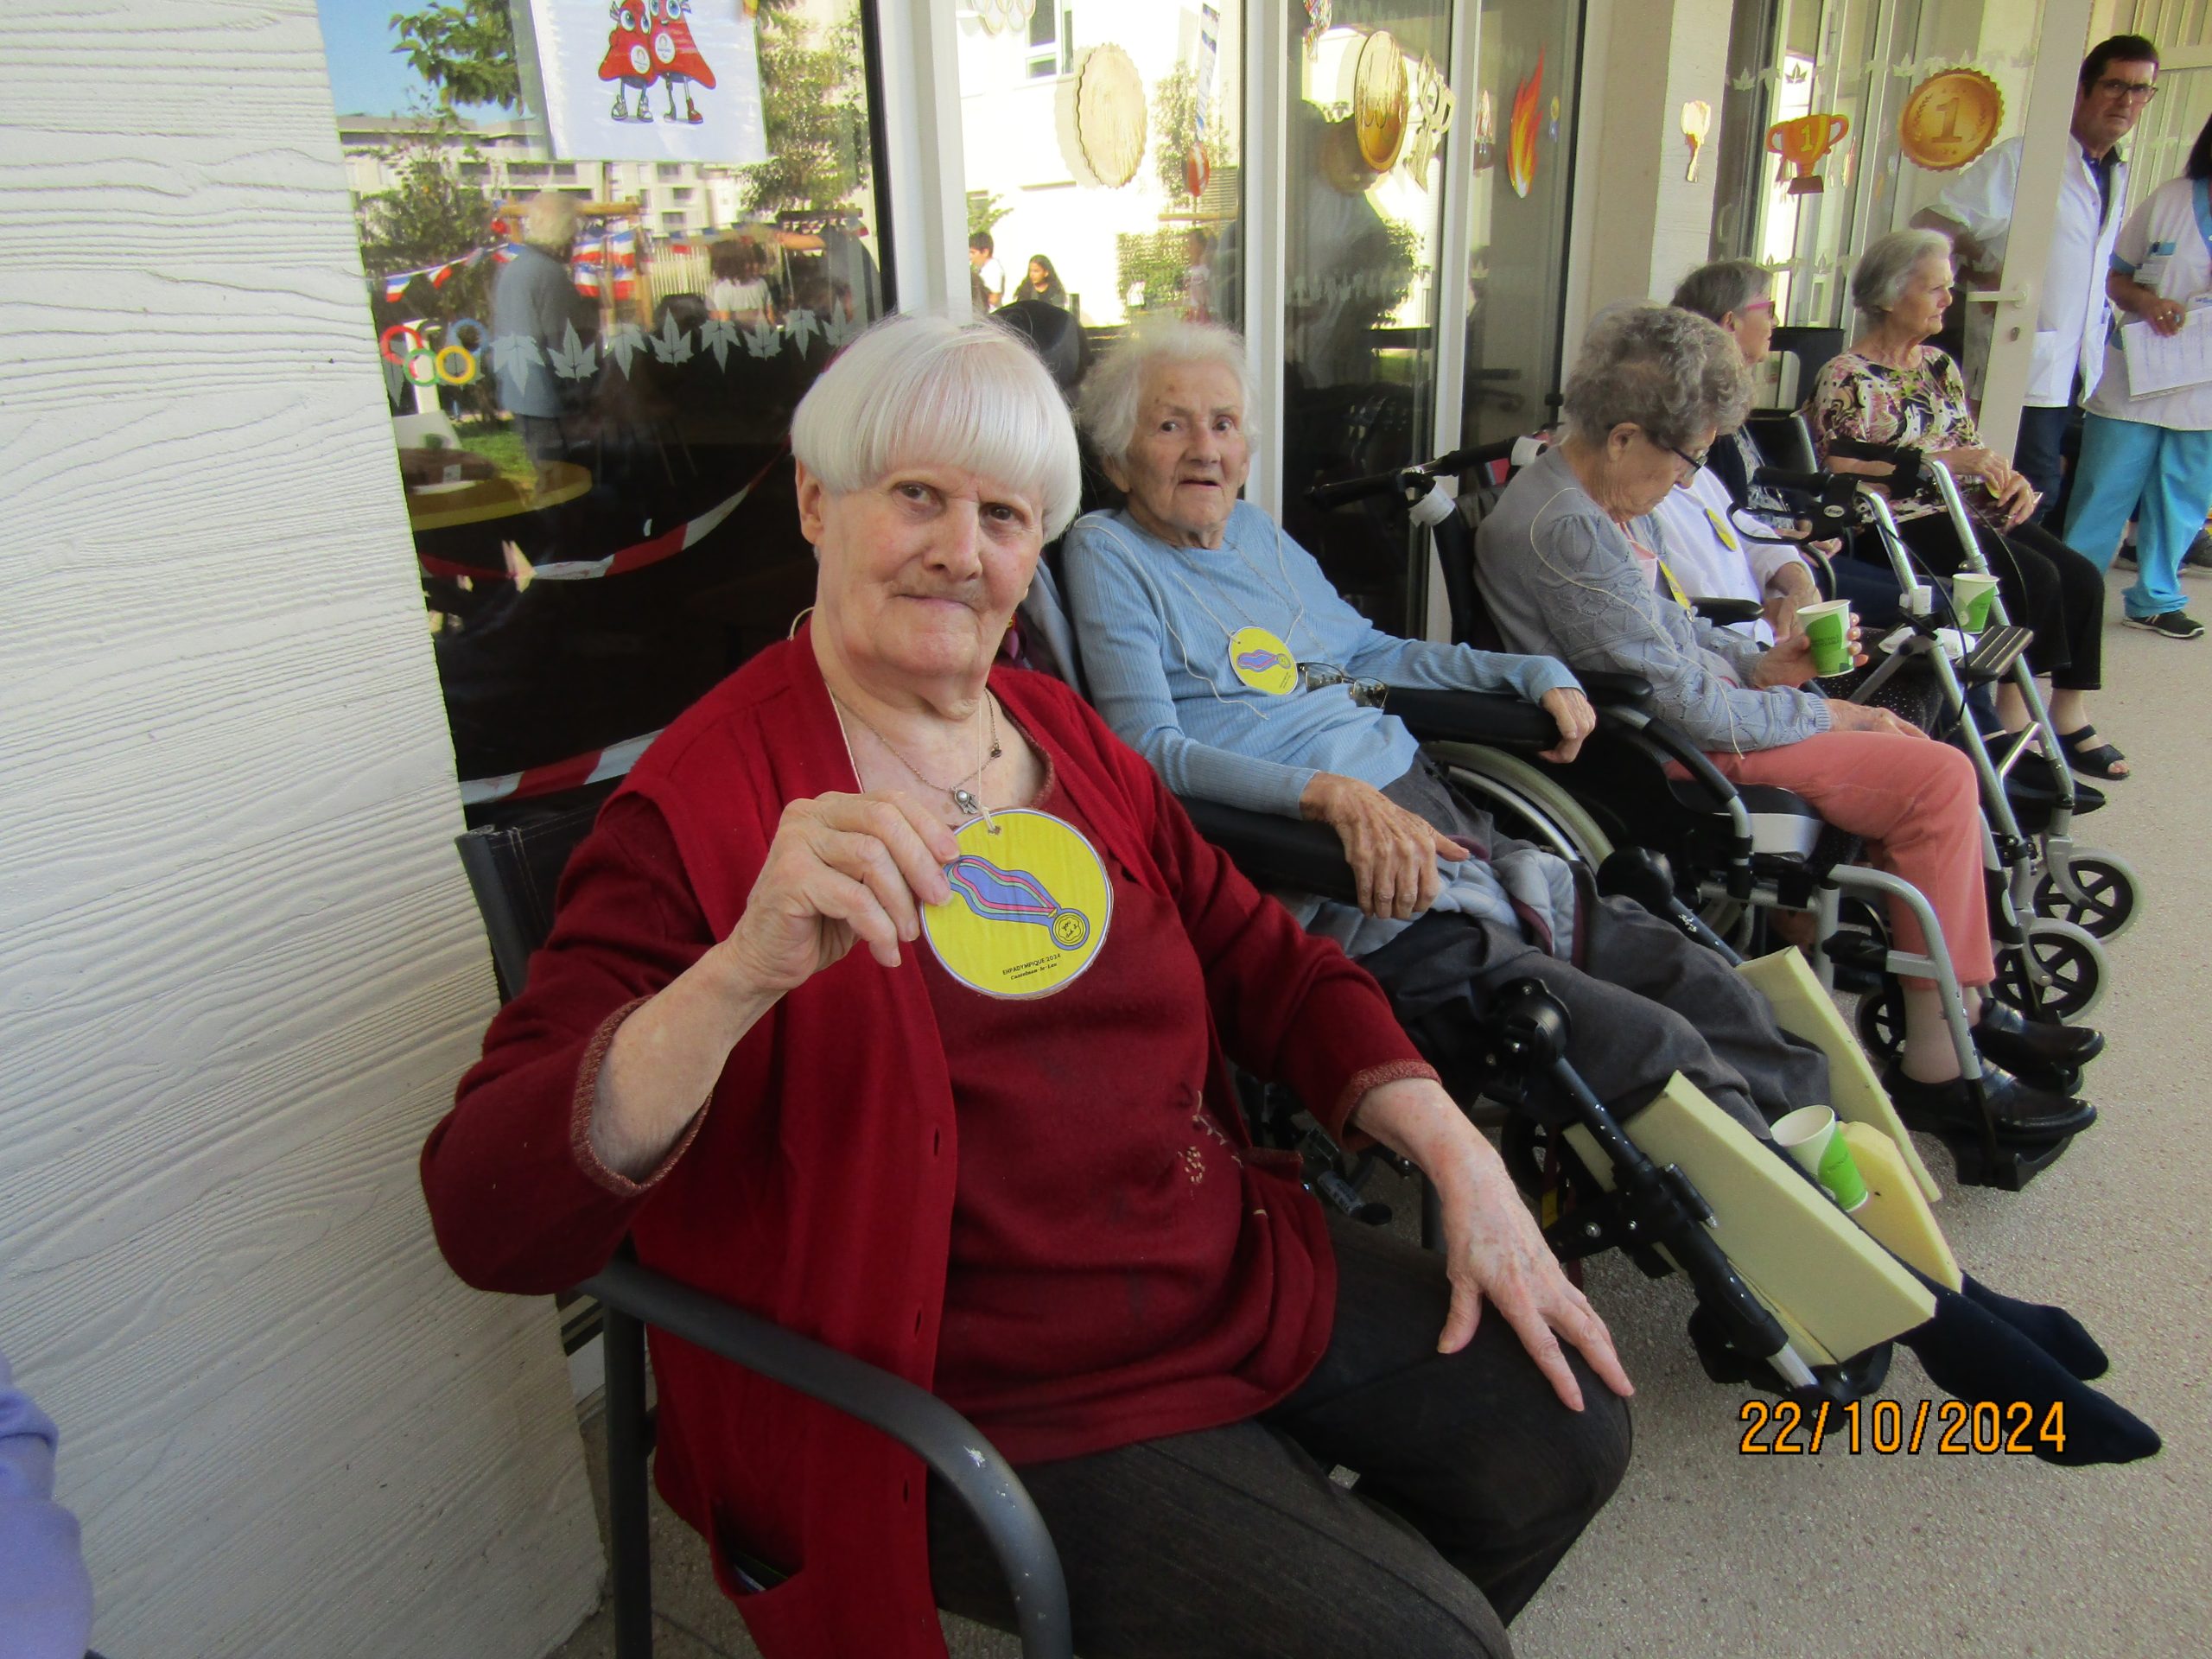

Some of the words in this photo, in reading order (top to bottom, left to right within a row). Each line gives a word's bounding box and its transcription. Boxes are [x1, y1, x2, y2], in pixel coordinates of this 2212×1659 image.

[1930, 97, 1963, 143] 1
[1800, 124, 1815, 152] 1
[1046, 953, 1061, 962] 2024
